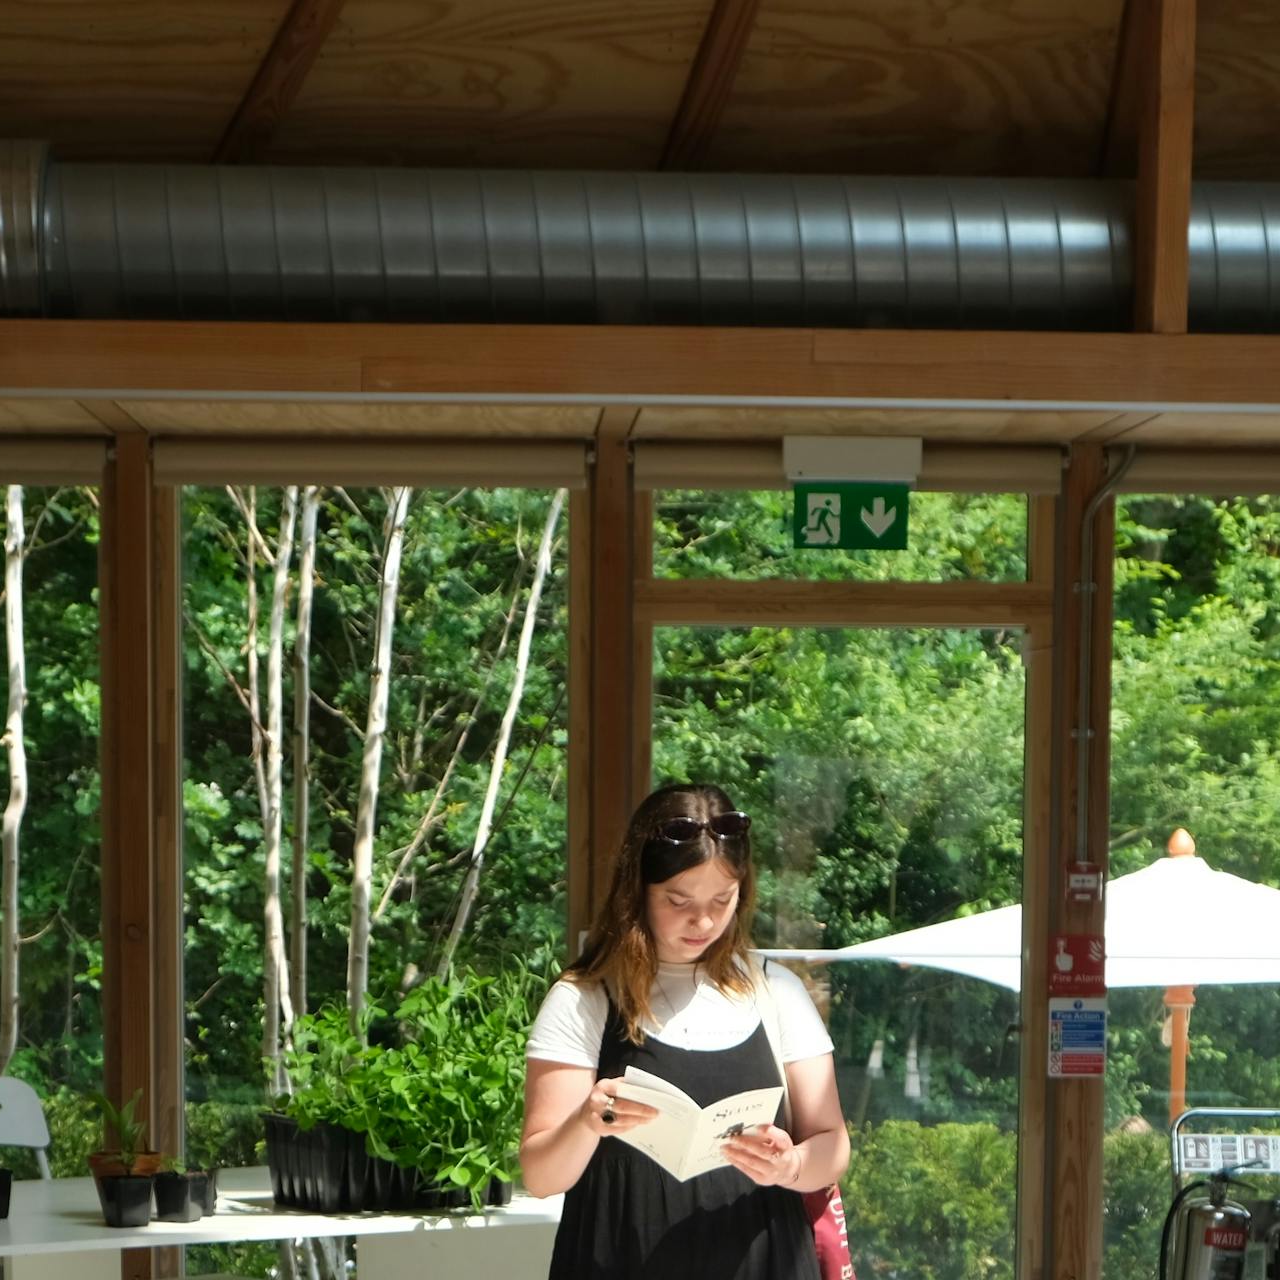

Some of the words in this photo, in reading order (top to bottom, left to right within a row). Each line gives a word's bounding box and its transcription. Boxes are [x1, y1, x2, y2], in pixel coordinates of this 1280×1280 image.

[1053, 974, 1072, 984] Fire
[1075, 974, 1105, 984] Alarm
[1212, 1231, 1244, 1246] WATER
